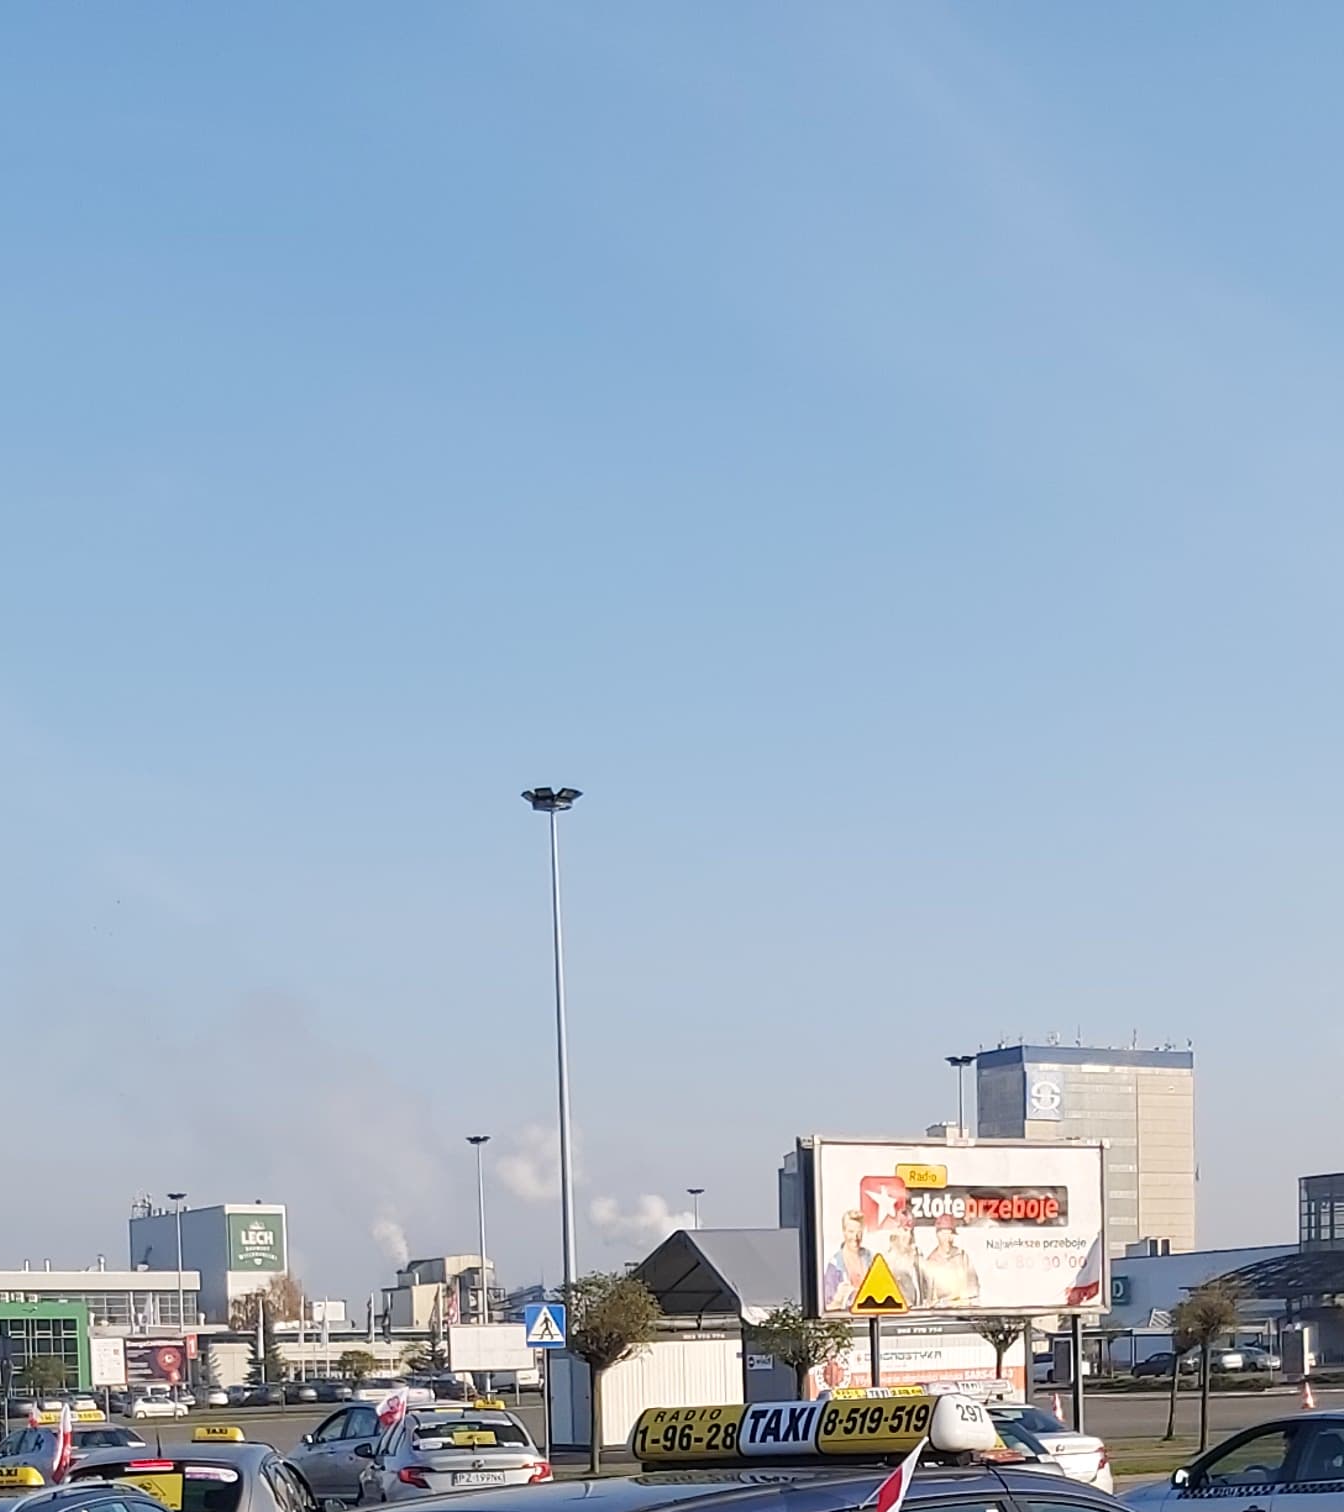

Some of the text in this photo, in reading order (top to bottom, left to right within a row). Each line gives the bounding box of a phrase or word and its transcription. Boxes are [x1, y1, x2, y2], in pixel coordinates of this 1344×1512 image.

[241, 1230, 274, 1246] LECH
[654, 1408, 722, 1423] RADIO
[956, 1404, 984, 1423] 297
[749, 1406, 817, 1443] TAXI
[638, 1423, 737, 1452] 1-96-28
